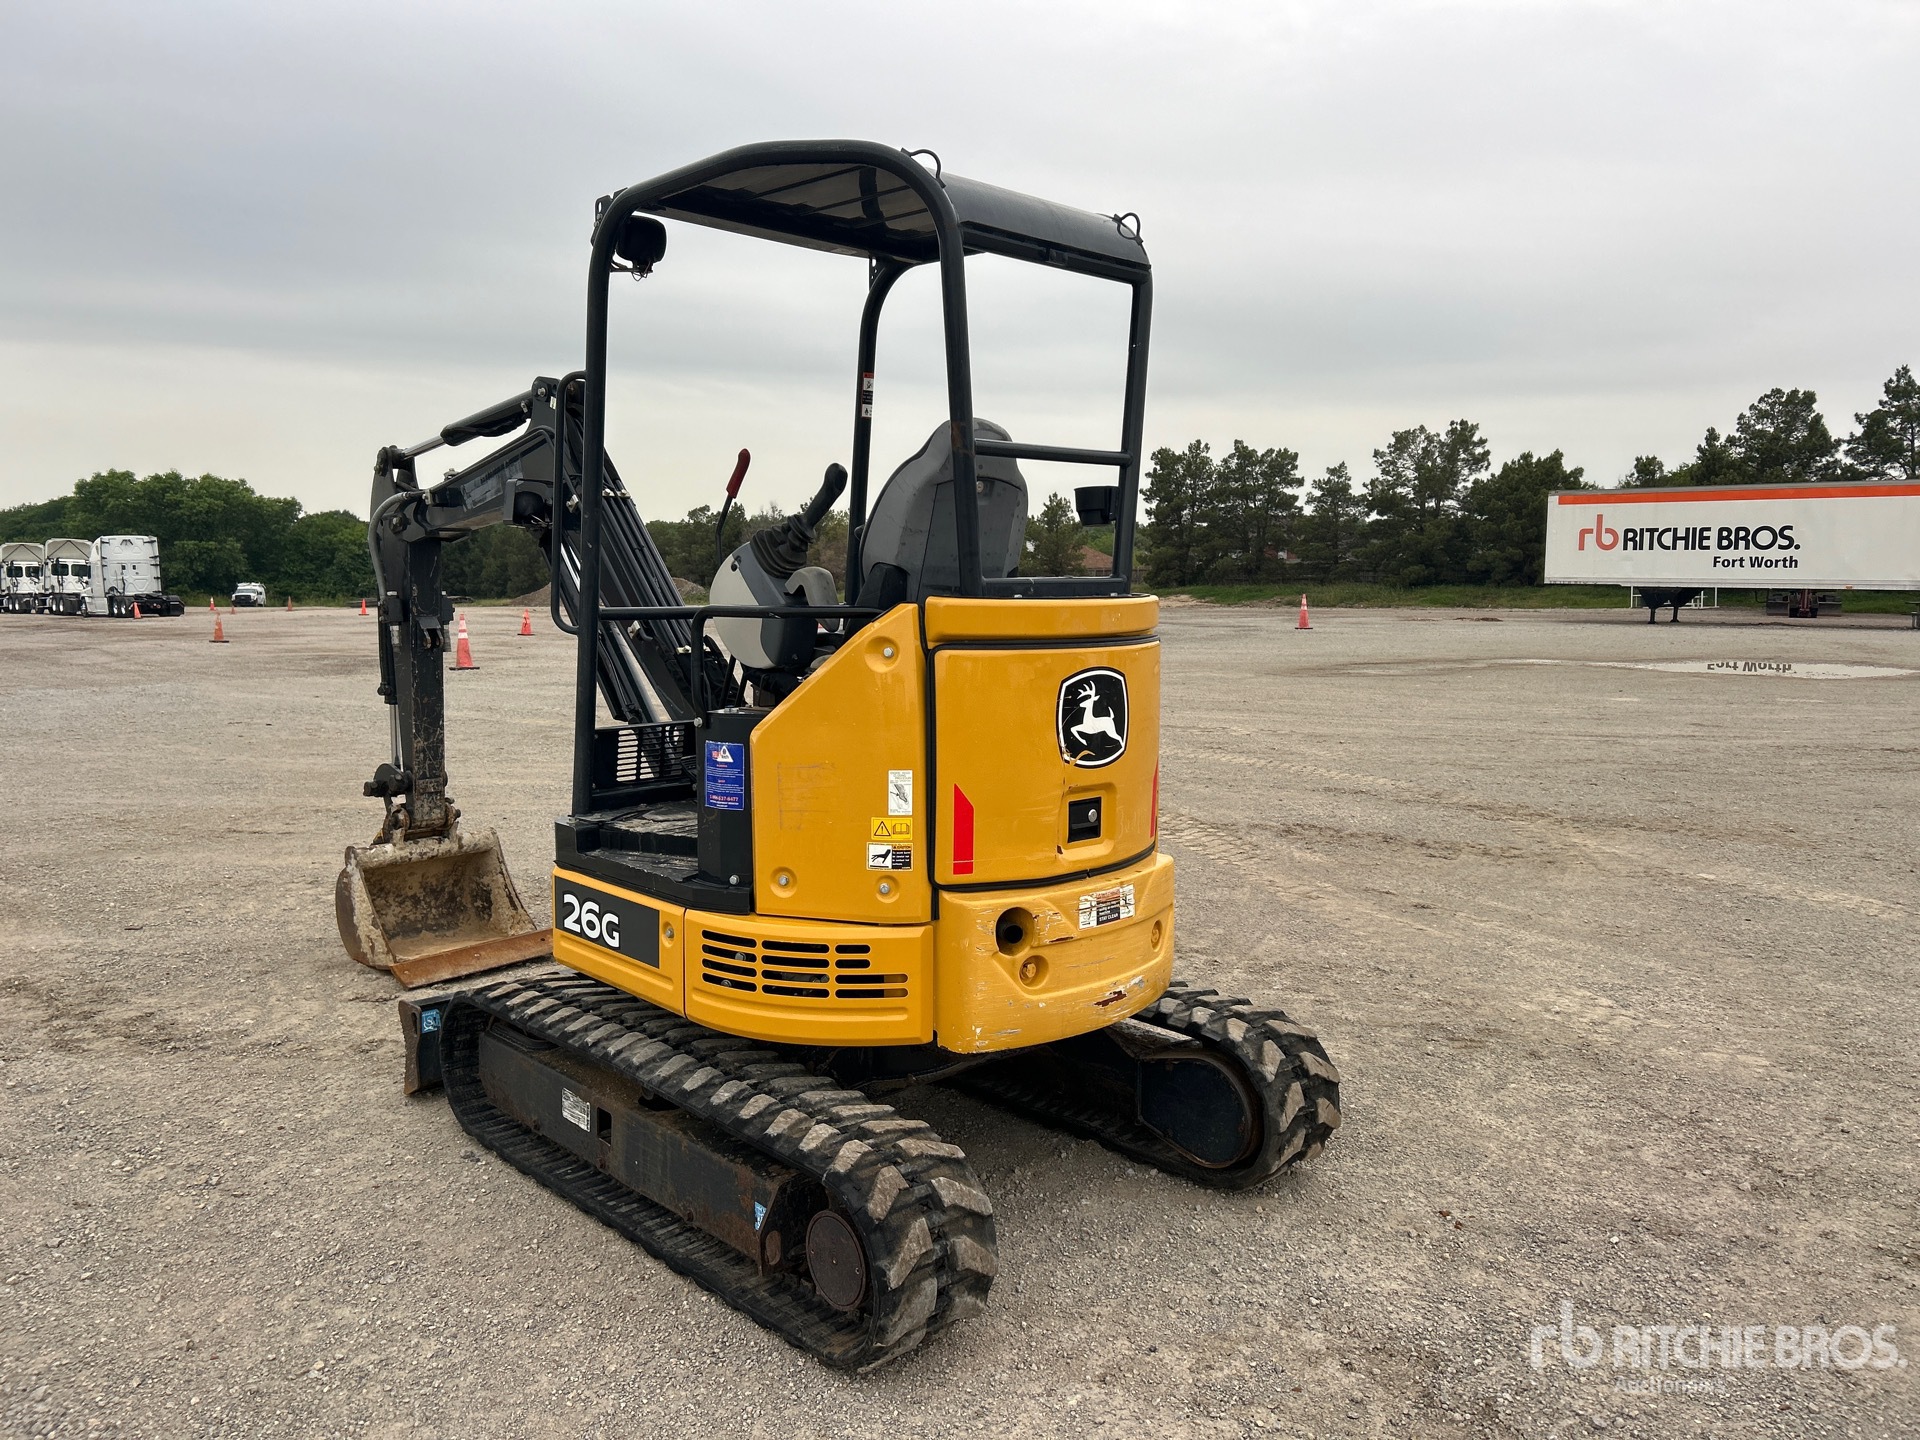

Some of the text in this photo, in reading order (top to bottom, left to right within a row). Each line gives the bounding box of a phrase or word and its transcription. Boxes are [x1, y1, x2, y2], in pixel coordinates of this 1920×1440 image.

[1578, 514, 1800, 550] rb RITCHIE BROS.
[1713, 556, 1798, 568] Fort Worth
[563, 894, 620, 947] 26G
